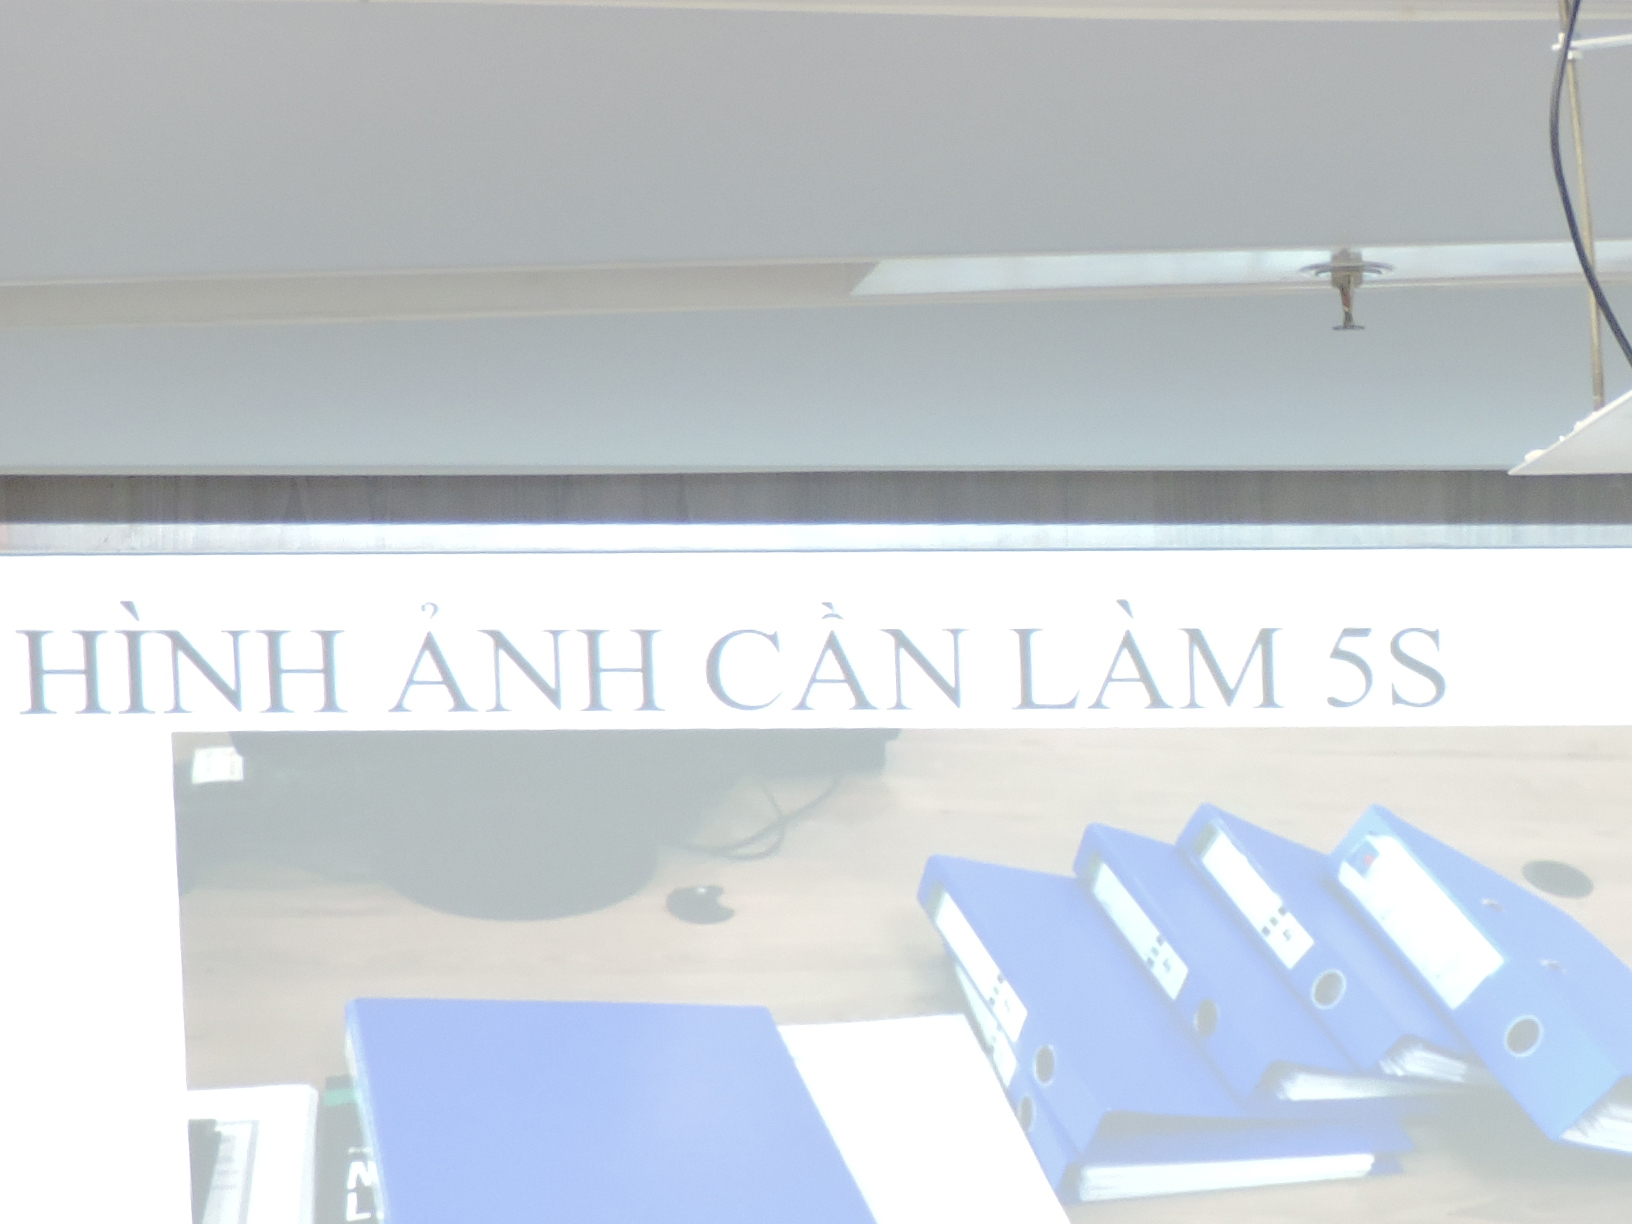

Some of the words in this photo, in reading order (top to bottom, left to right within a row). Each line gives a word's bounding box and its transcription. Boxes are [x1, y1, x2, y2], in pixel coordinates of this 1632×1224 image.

[15, 600, 348, 715] HÌNH
[388, 601, 666, 714] ẢNH
[705, 602, 970, 711] CẦN
[1010, 599, 1285, 710] LÀM
[1326, 627, 1447, 708] 5S
